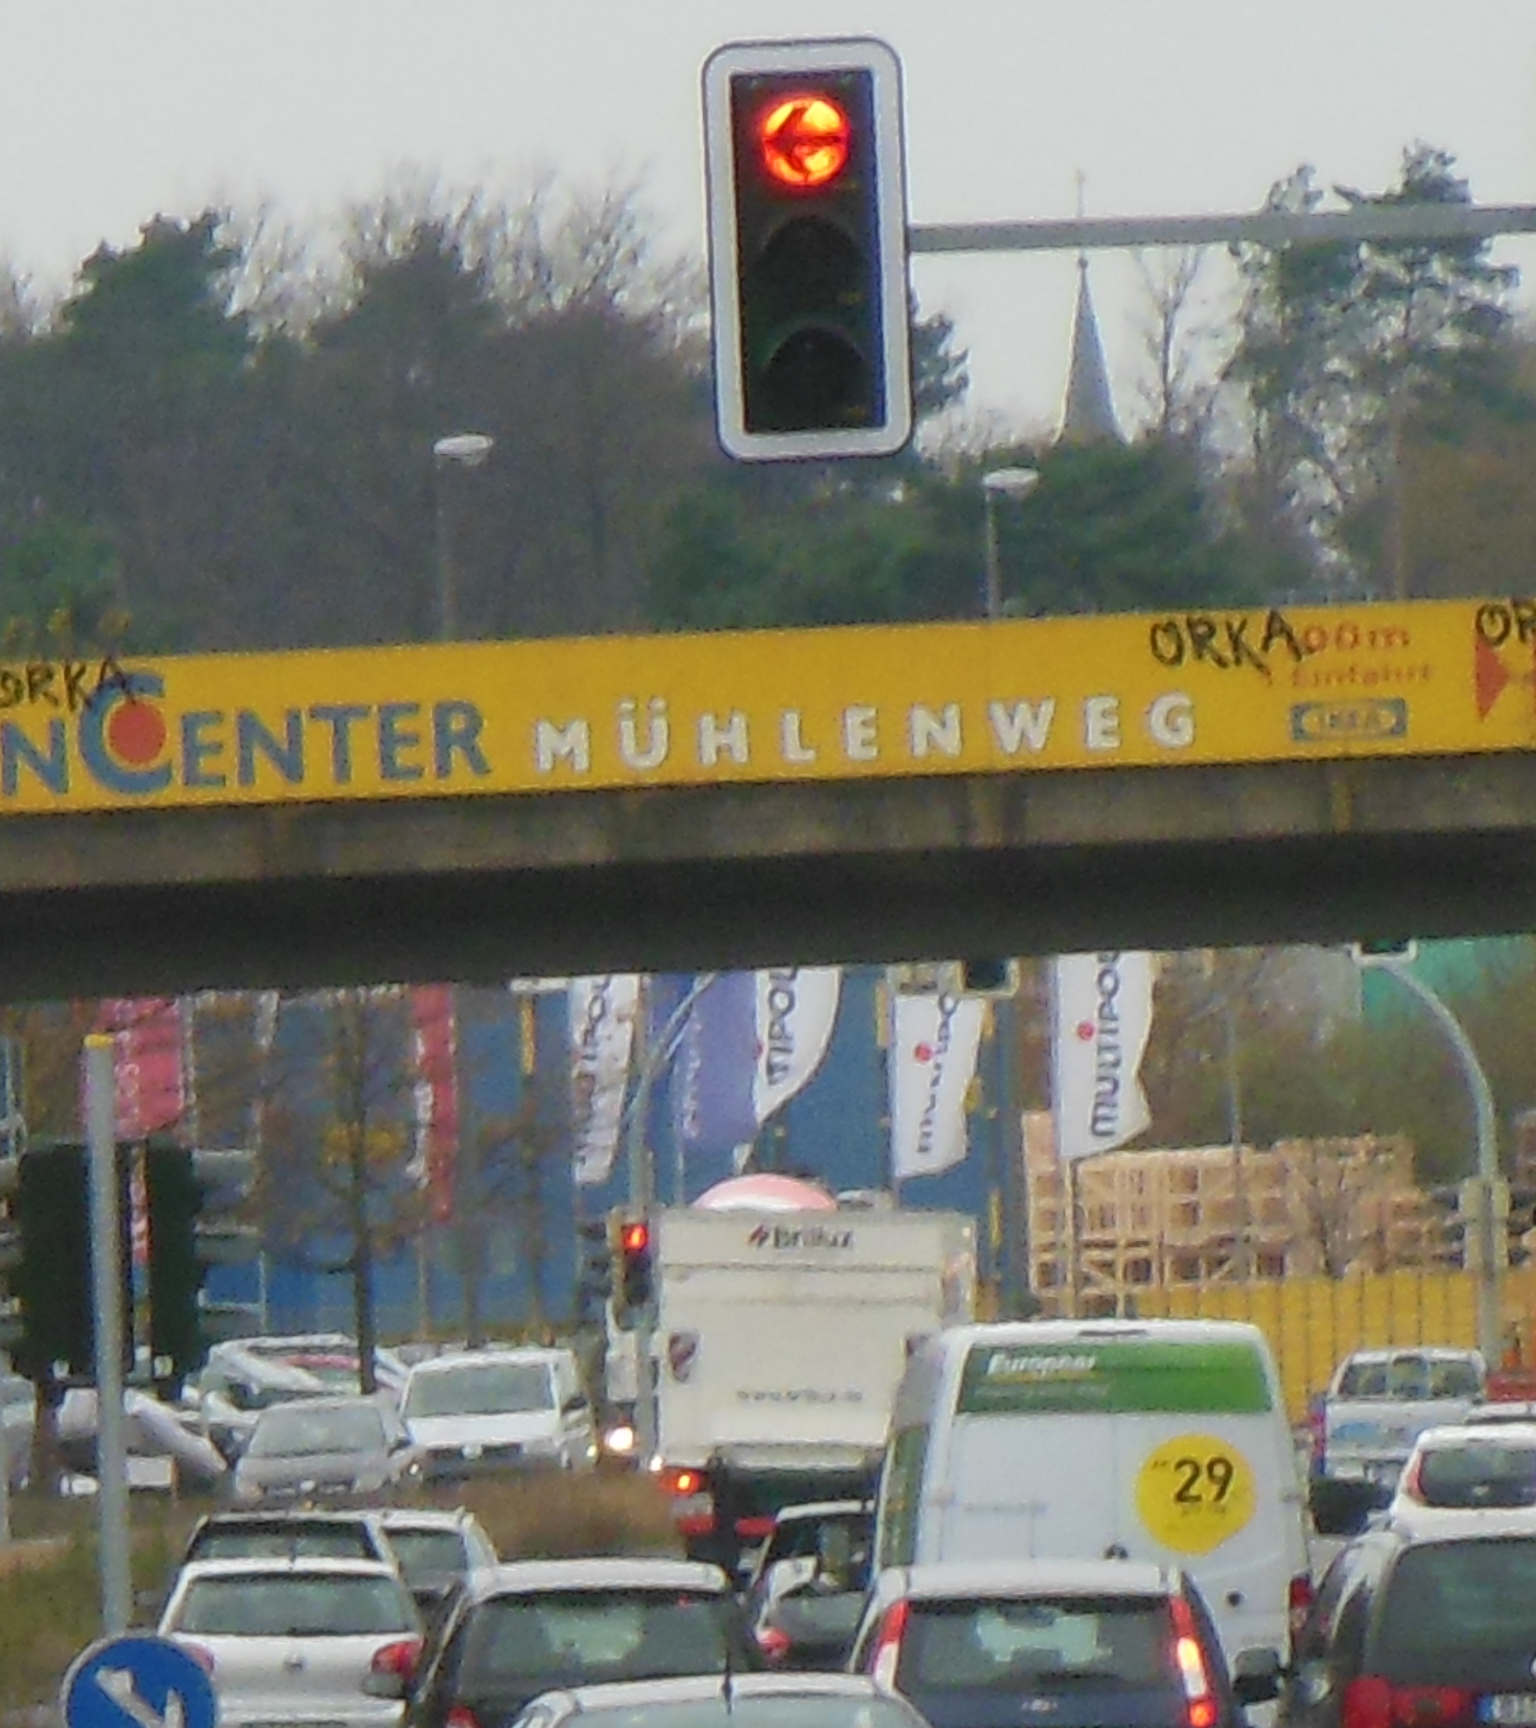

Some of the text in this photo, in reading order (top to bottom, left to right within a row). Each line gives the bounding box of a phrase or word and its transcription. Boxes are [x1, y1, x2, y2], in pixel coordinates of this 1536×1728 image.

[1150, 609, 1304, 677] ORKA
[534, 691, 1198, 774] MÜHLENWEG
[1173, 1457, 1234, 1503] 29
